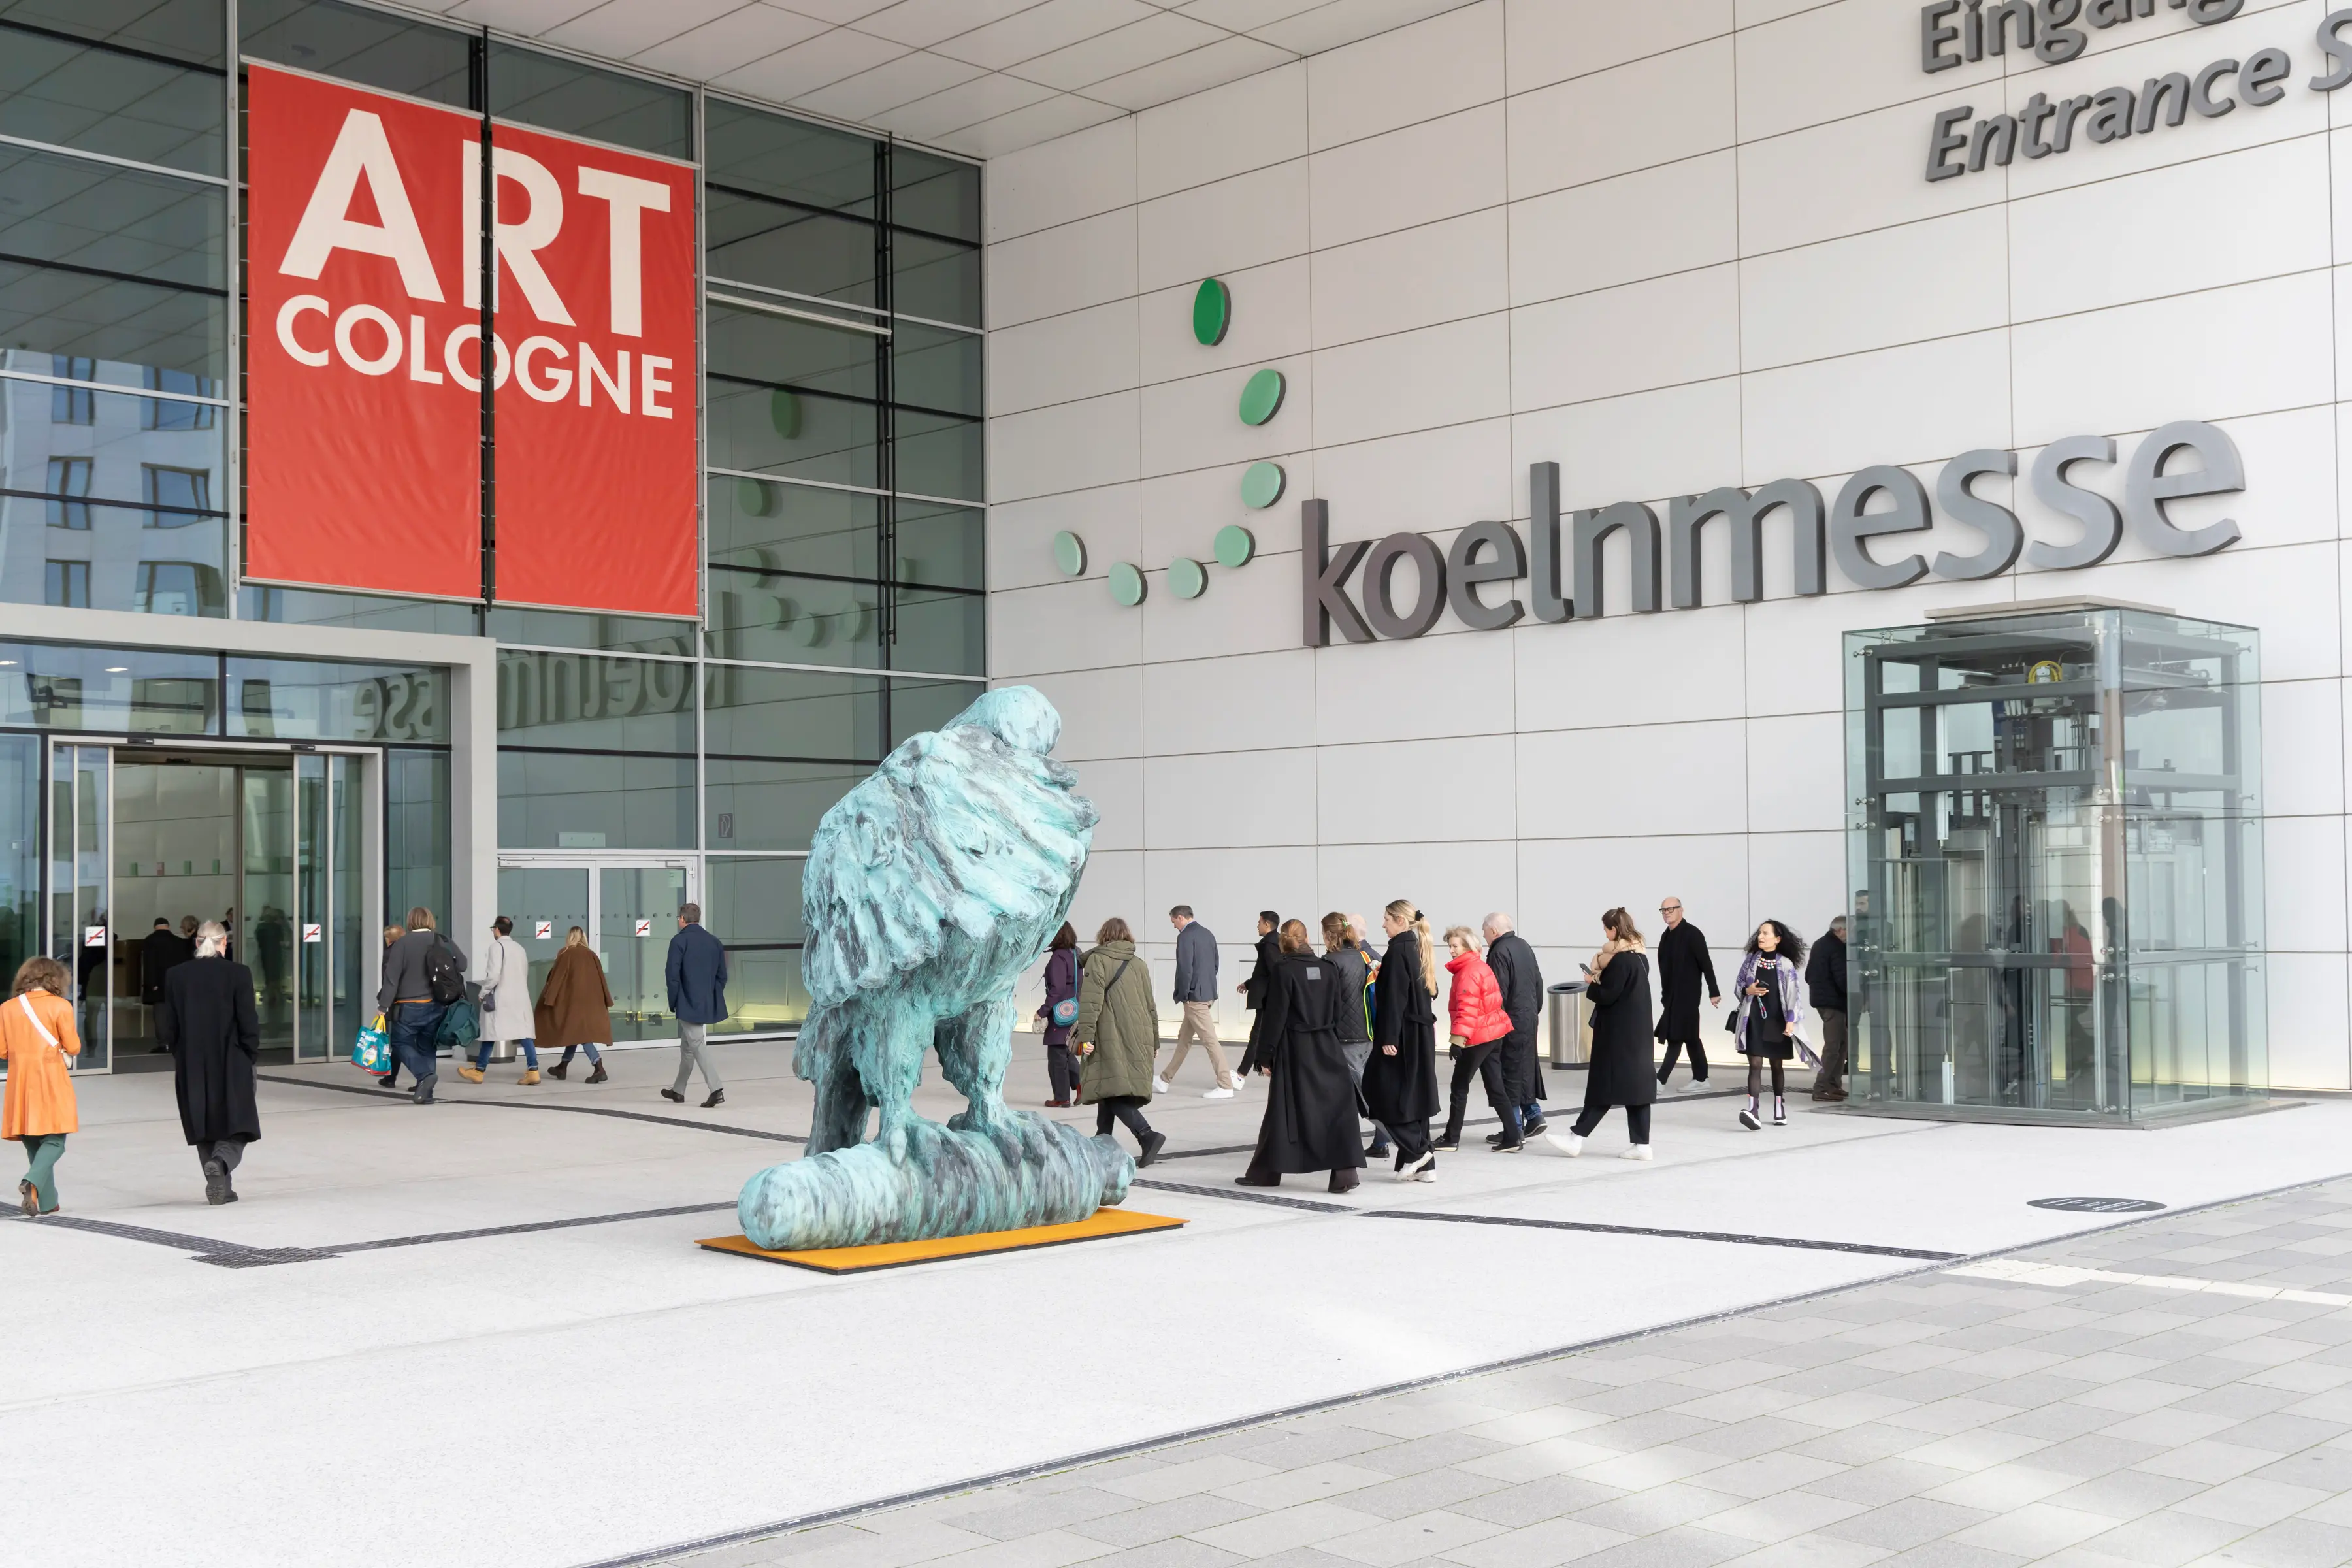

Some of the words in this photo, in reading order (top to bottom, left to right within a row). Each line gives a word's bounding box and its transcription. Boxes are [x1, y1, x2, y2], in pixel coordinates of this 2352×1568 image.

[1925, 48, 2291, 182] Entrance
[278, 108, 670, 338] ART
[276, 295, 672, 419] COLOGNE
[1301, 419, 2246, 647] koelnmesse
